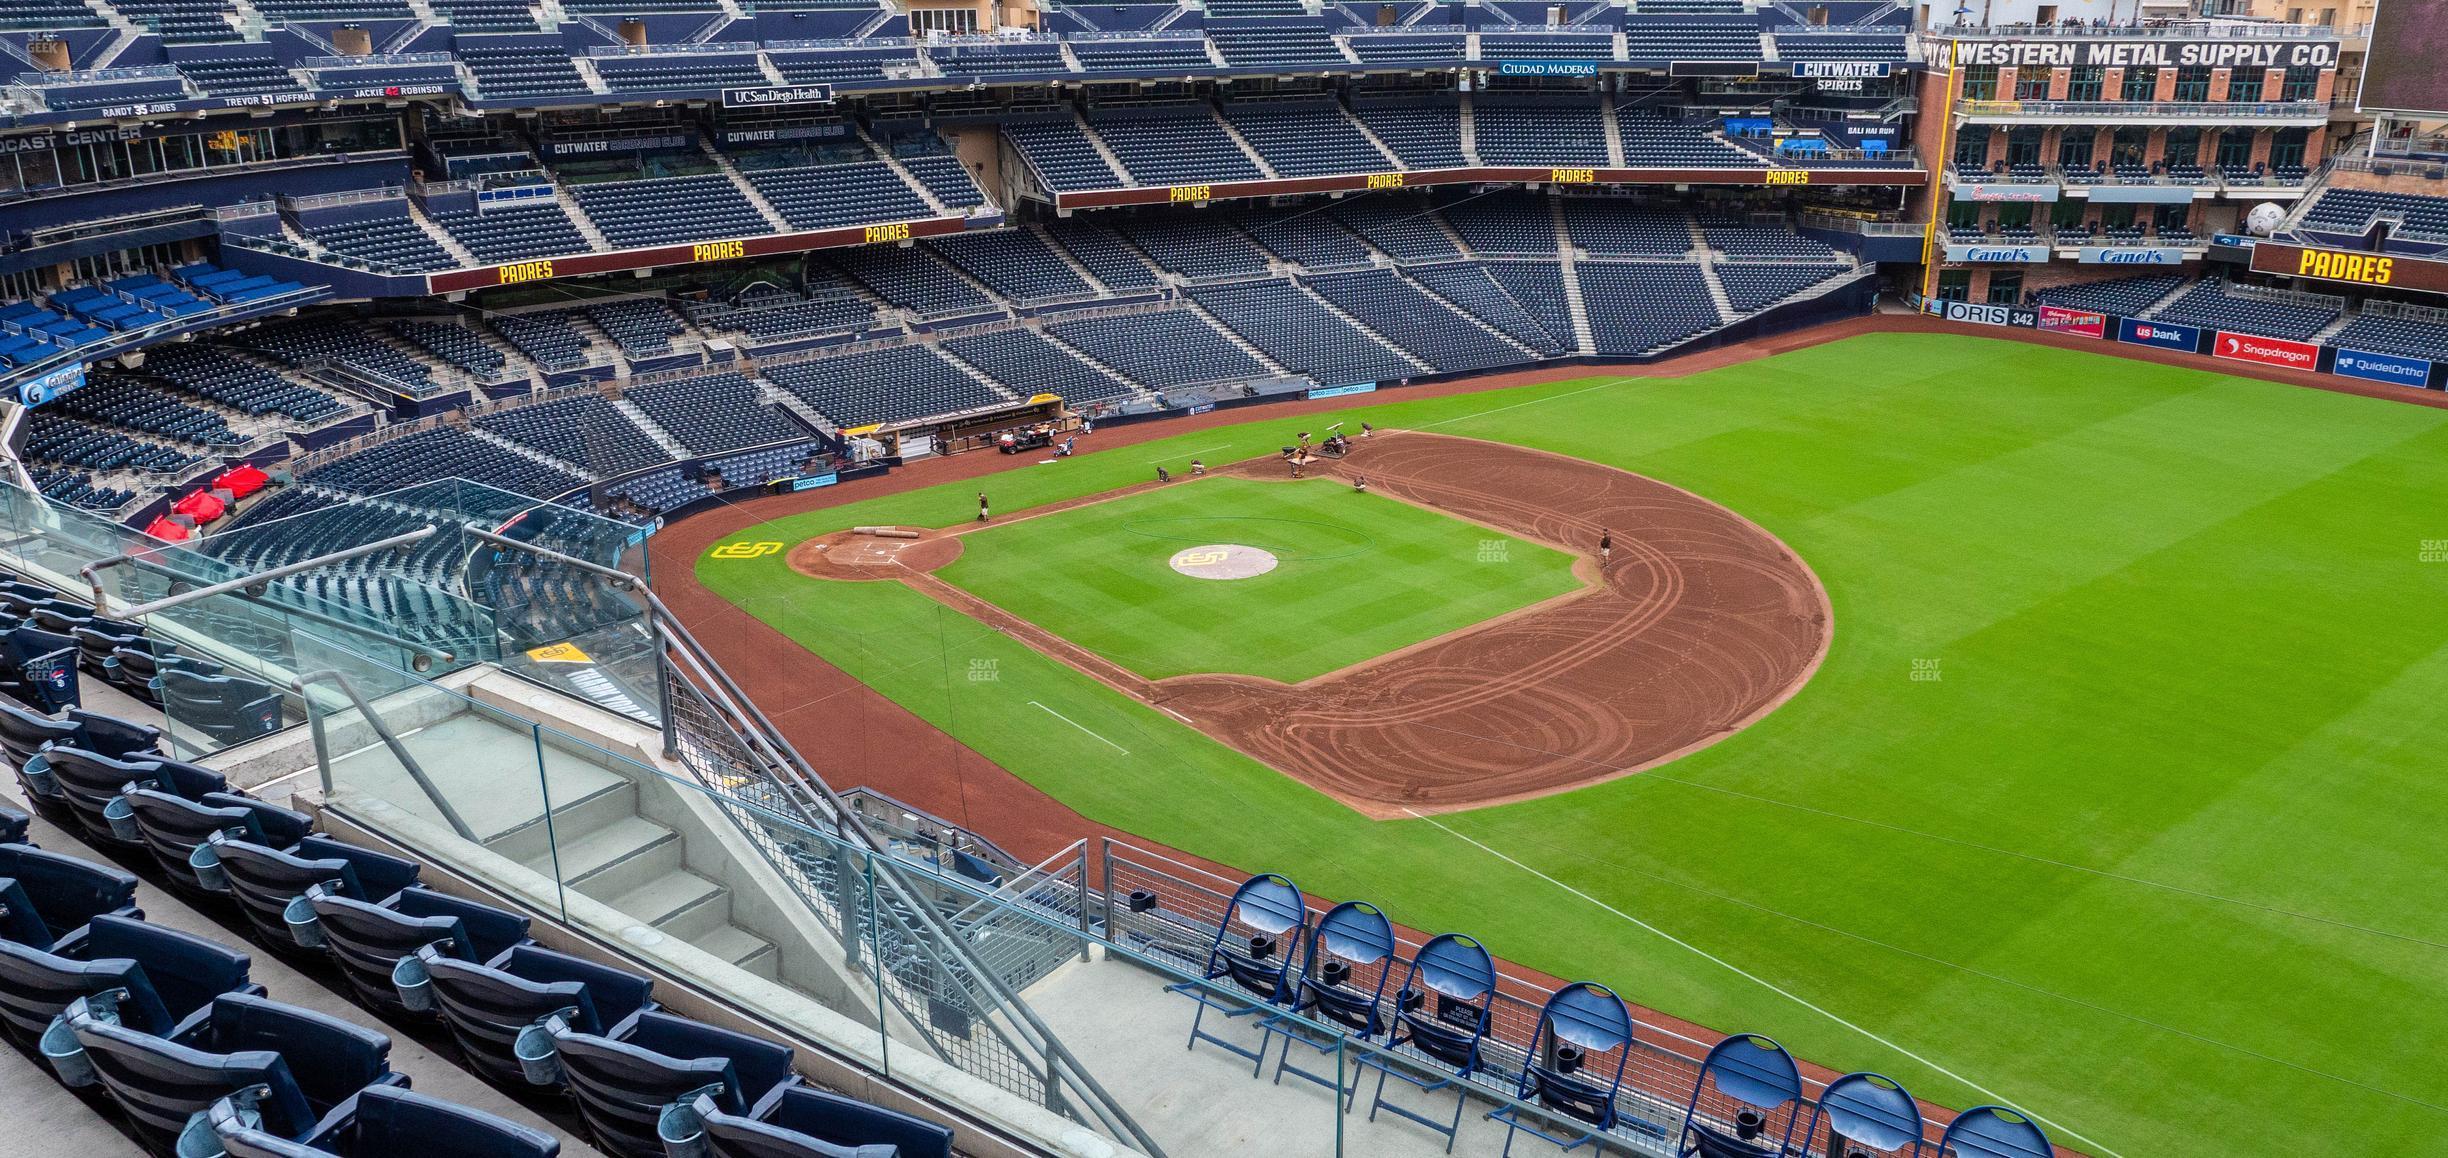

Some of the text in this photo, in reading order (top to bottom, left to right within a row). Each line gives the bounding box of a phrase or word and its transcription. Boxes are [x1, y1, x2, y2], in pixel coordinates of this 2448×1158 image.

[1956, 43, 2334, 66] WESTERN METAL SUPPLY CO.
[1502, 63, 1595, 74] CIUDAD MADERAS
[1804, 63, 1879, 76] CUTWATER
[353, 85, 443, 98] JACKIE 42 ROBINSON
[1817, 80, 1862, 91] SPIRITS
[225, 93, 316, 107] TREVOR 51 HOFFMAN
[735, 88, 821, 103] UC San Diego Health
[103, 103, 176, 118] RANDY 35 JONES
[66, 128, 142, 146] CENTER
[728, 130, 774, 142] CUTWATER
[554, 141, 607, 154] CUTWATER
[1367, 174, 1403, 188] PADRES
[1552, 169, 1593, 182] PADRES
[1766, 171, 1809, 184] PADRES
[1170, 185, 1210, 201] PADRES
[865, 224, 909, 242] PADRES
[694, 241, 744, 261] PADRES
[1966, 247, 2030, 262] Canel's
[2100, 249, 2163, 263] Canel's
[499, 260, 553, 284] PADRES
[2298, 249, 2393, 285] PADRES
[1950, 304, 2005, 324] ORIS
[2012, 312, 2034, 326] 342
[2137, 327, 2181, 342] us bank
[2243, 343, 2310, 362] Snapdragon
[2356, 359, 2424, 377] QuidelOrtho
[794, 479, 815, 489] petco
